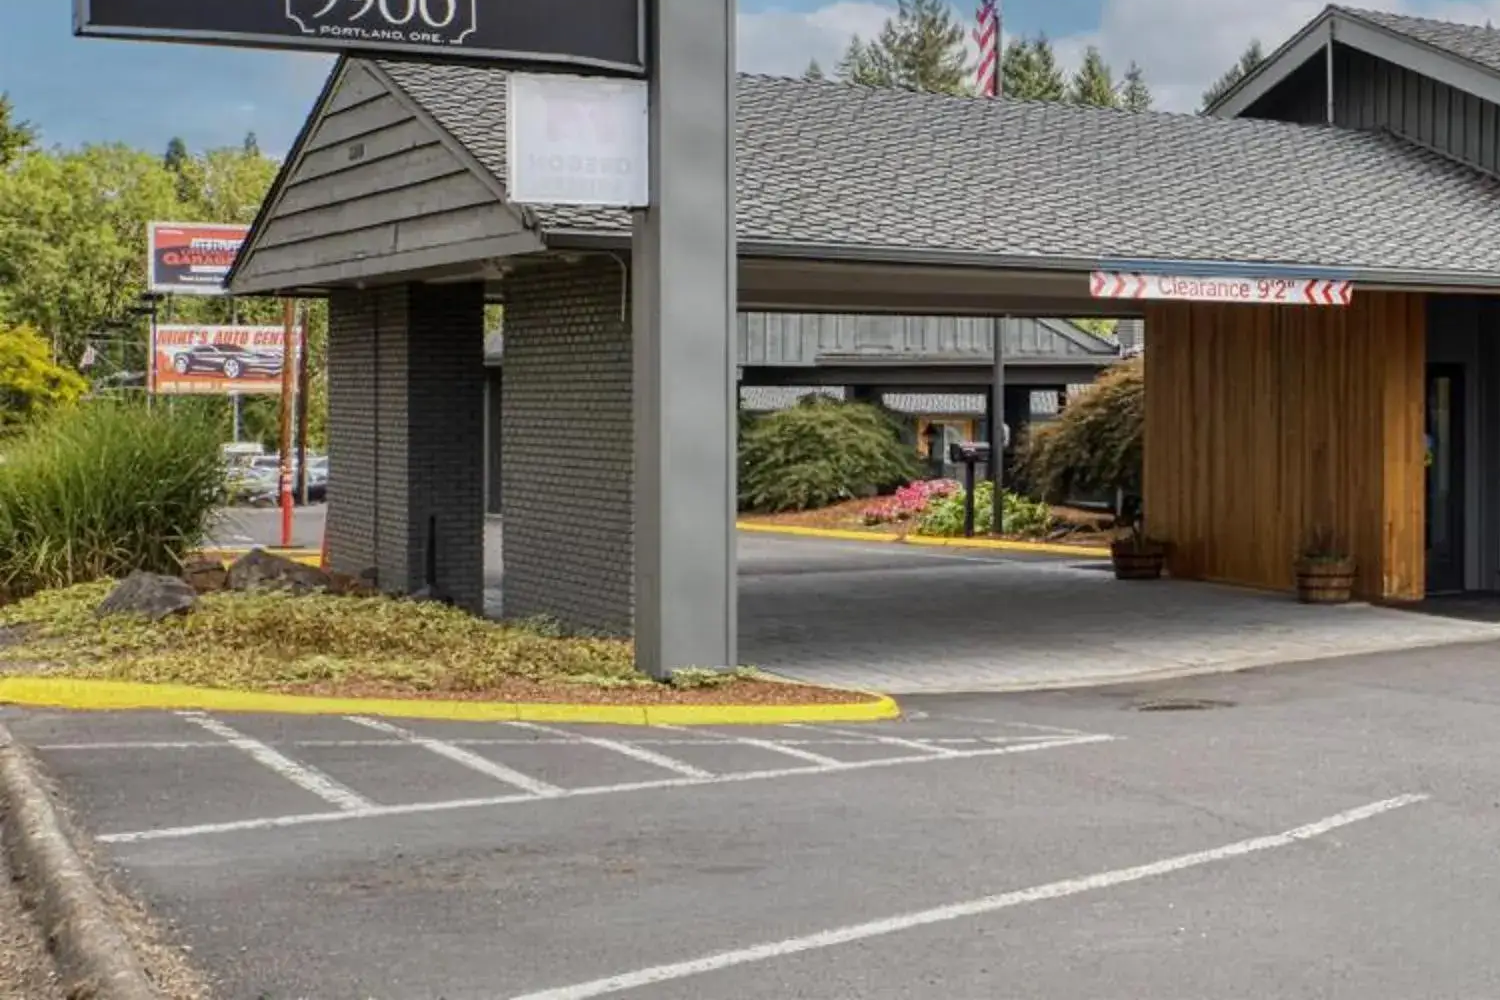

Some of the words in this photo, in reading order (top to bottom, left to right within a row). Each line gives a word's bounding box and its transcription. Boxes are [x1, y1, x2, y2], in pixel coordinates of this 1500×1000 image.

[1157, 275, 1250, 298] Clearance
[213, 331, 249, 345] AUTO
[253, 331, 294, 346] CENT
